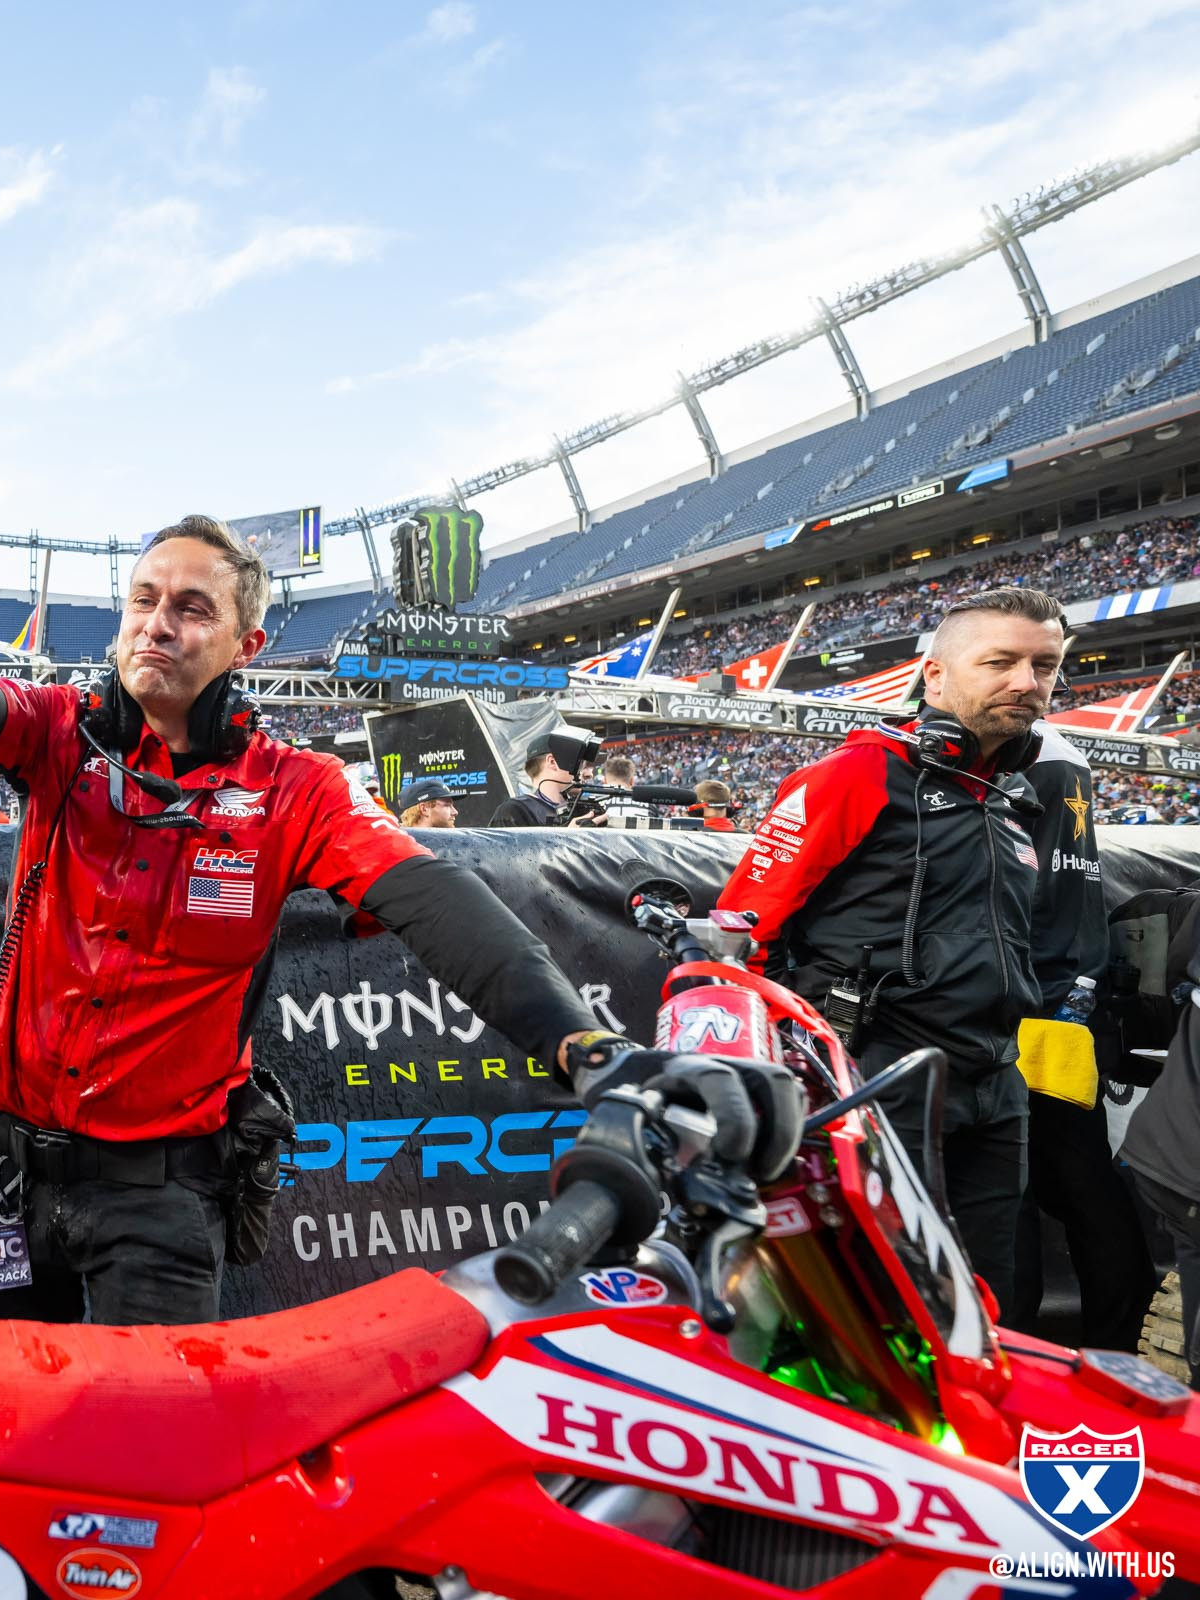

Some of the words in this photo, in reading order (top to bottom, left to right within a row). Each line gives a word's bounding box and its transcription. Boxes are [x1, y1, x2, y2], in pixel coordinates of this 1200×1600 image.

[386, 611, 510, 637] MONSTER
[342, 642, 369, 656] AMA
[406, 638, 493, 650] ENERGY
[334, 656, 570, 689] SUPERCROSS
[684, 694, 717, 707] ROCKY
[719, 697, 772, 712] MOUNTAIN
[821, 709, 855, 721] ROCKY
[1094, 739, 1141, 753] MOUNTAIN
[418, 749, 466, 765] MONSTER
[425, 763, 458, 772] ENERGY
[210, 806, 266, 817] HONDA
[194, 847, 259, 870] HRC
[277, 978, 626, 1050] MONSR
[345, 1057, 549, 1086] ENERG
[292, 1200, 552, 1262] CHAMPIO
[535, 1391, 1000, 1548] HONDA
[65, 1562, 109, 1588] Twin
[107, 1567, 138, 1590] Air
